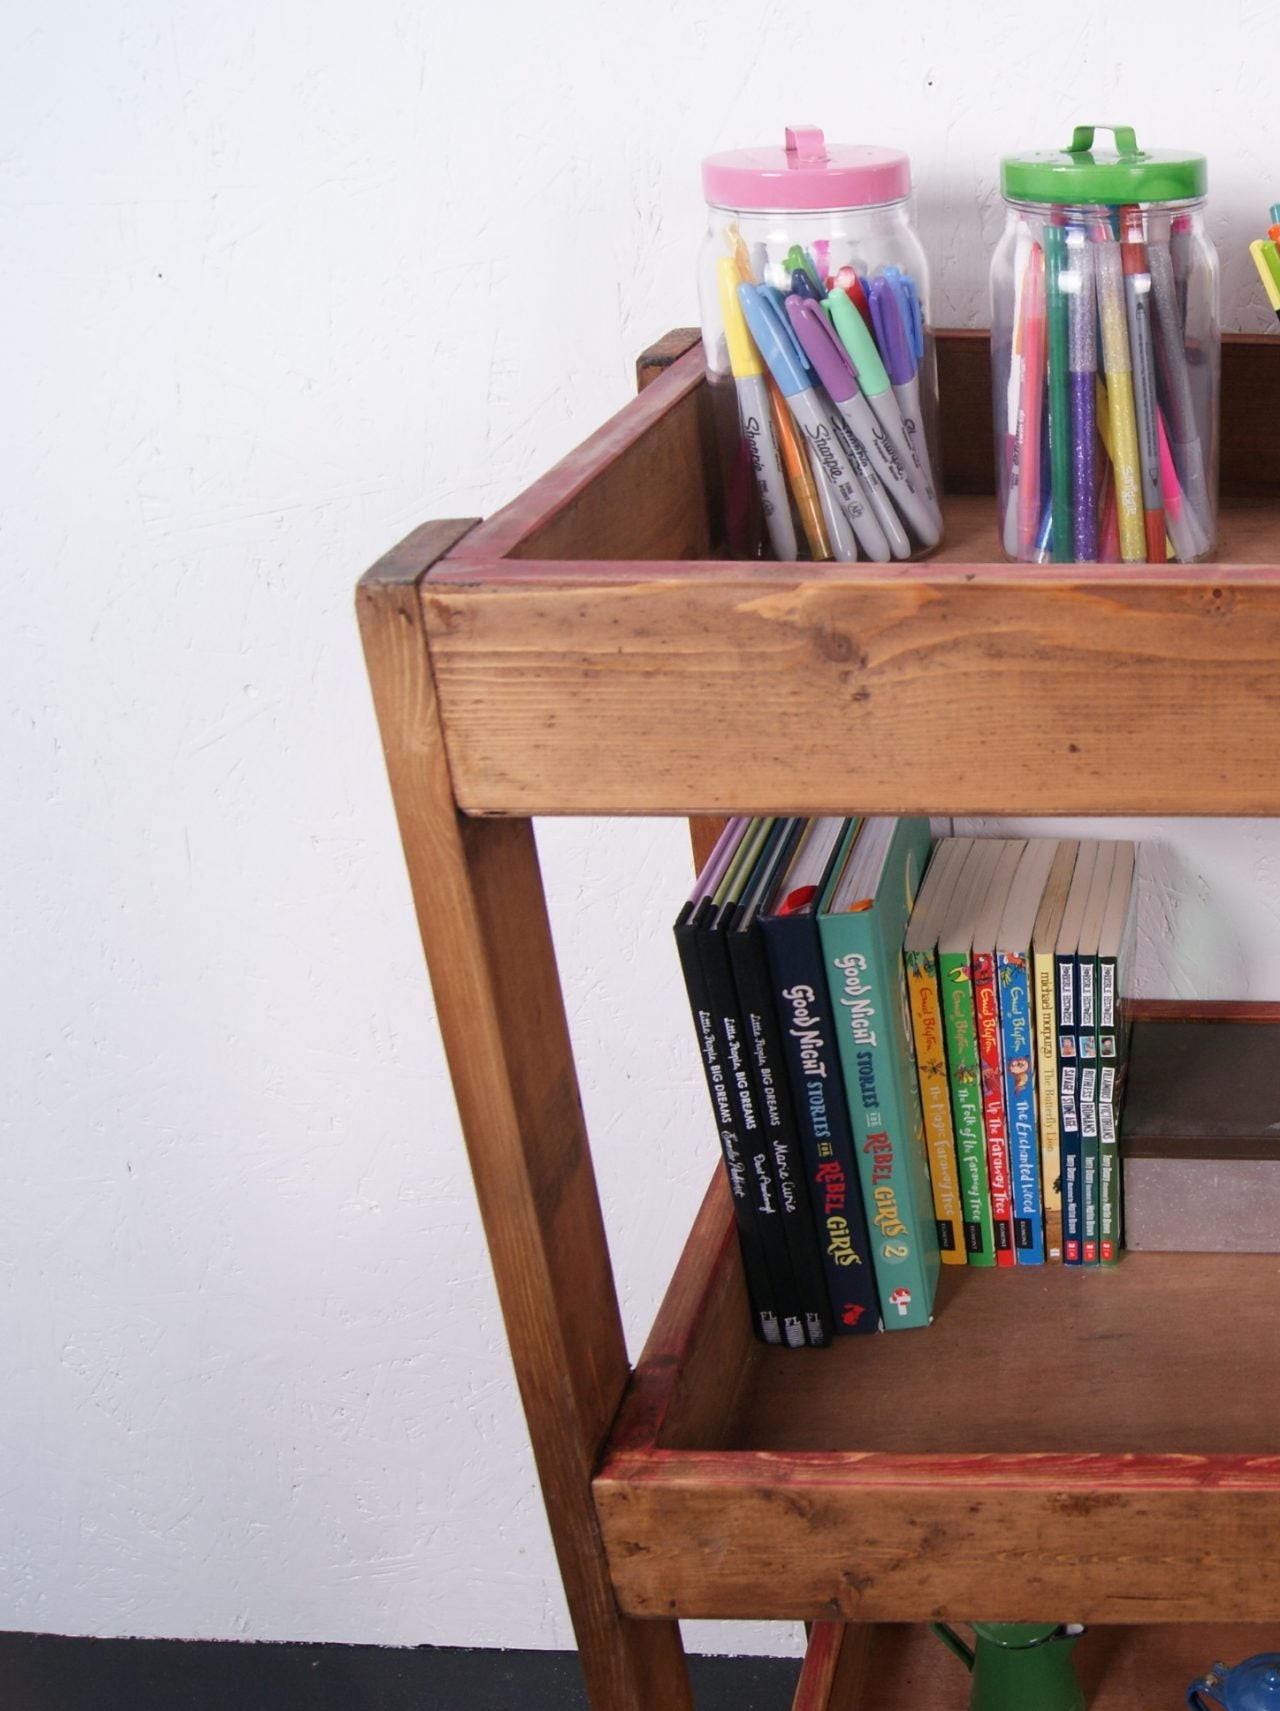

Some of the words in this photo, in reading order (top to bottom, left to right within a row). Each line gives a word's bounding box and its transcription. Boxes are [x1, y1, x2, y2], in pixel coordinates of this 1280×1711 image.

[981, 988, 993, 1015] Enid
[1010, 987, 1024, 1015] Enid
[1041, 972, 1053, 1010] michael
[699, 1010, 711, 1034] Little
[724, 1017, 736, 1041] Little
[750, 1013, 761, 1037] Little
[981, 1018, 996, 1053] Blyton
[1010, 1018, 1025, 1053] Blyton
[1041, 1013, 1052, 1058] morpurgo
[710, 1065, 723, 1082] BIG
[735, 1071, 748, 1089] BIG
[761, 1068, 773, 1085] BIG
[856, 1052, 879, 1108] STORIES
[1044, 1069, 1054, 1086] The
[1063, 1069, 1075, 1092] SAVAGE
[1082, 1070, 1094, 1099] RUTHLESS
[715, 1084, 732, 1123] DREAMS
[765, 1087, 780, 1126] DREAMS
[929, 1087, 940, 1101] The
[958, 1089, 969, 1103] The
[987, 1101, 1002, 1113] Up
[739, 1091, 757, 1130] DREAMS
[807, 1081, 831, 1138] STORIES
[931, 1104, 946, 1137] Magic
[962, 1104, 977, 1126] Folk
[1016, 1101, 1028, 1120] The
[1044, 1089, 1056, 1128] Butterfly
[1065, 1117, 1076, 1127] AGE
[1081, 1104, 1095, 1134] ROMANS
[1100, 1104, 1114, 1140] VICTORIANS
[960, 1128, 976, 1138] of
[988, 1118, 1002, 1134] The
[1015, 1122, 1034, 1181] Enchanted
[1047, 1132, 1056, 1152] Lion
[863, 1131, 893, 1185] REBEL
[934, 1141, 952, 1189] Faraway
[989, 1138, 1005, 1188] Faraway
[773, 1140, 789, 1180] Marie
[781, 1181, 796, 1213] Curie
[816, 1160, 846, 1214] REBEL
[963, 1156, 979, 1196] Faraway
[941, 1194, 953, 1216] Tree
[970, 1199, 981, 1220] Tree
[992, 1191, 1008, 1214] Tree
[1021, 1184, 1036, 1213] Wood
[884, 1245, 908, 1258] 2
